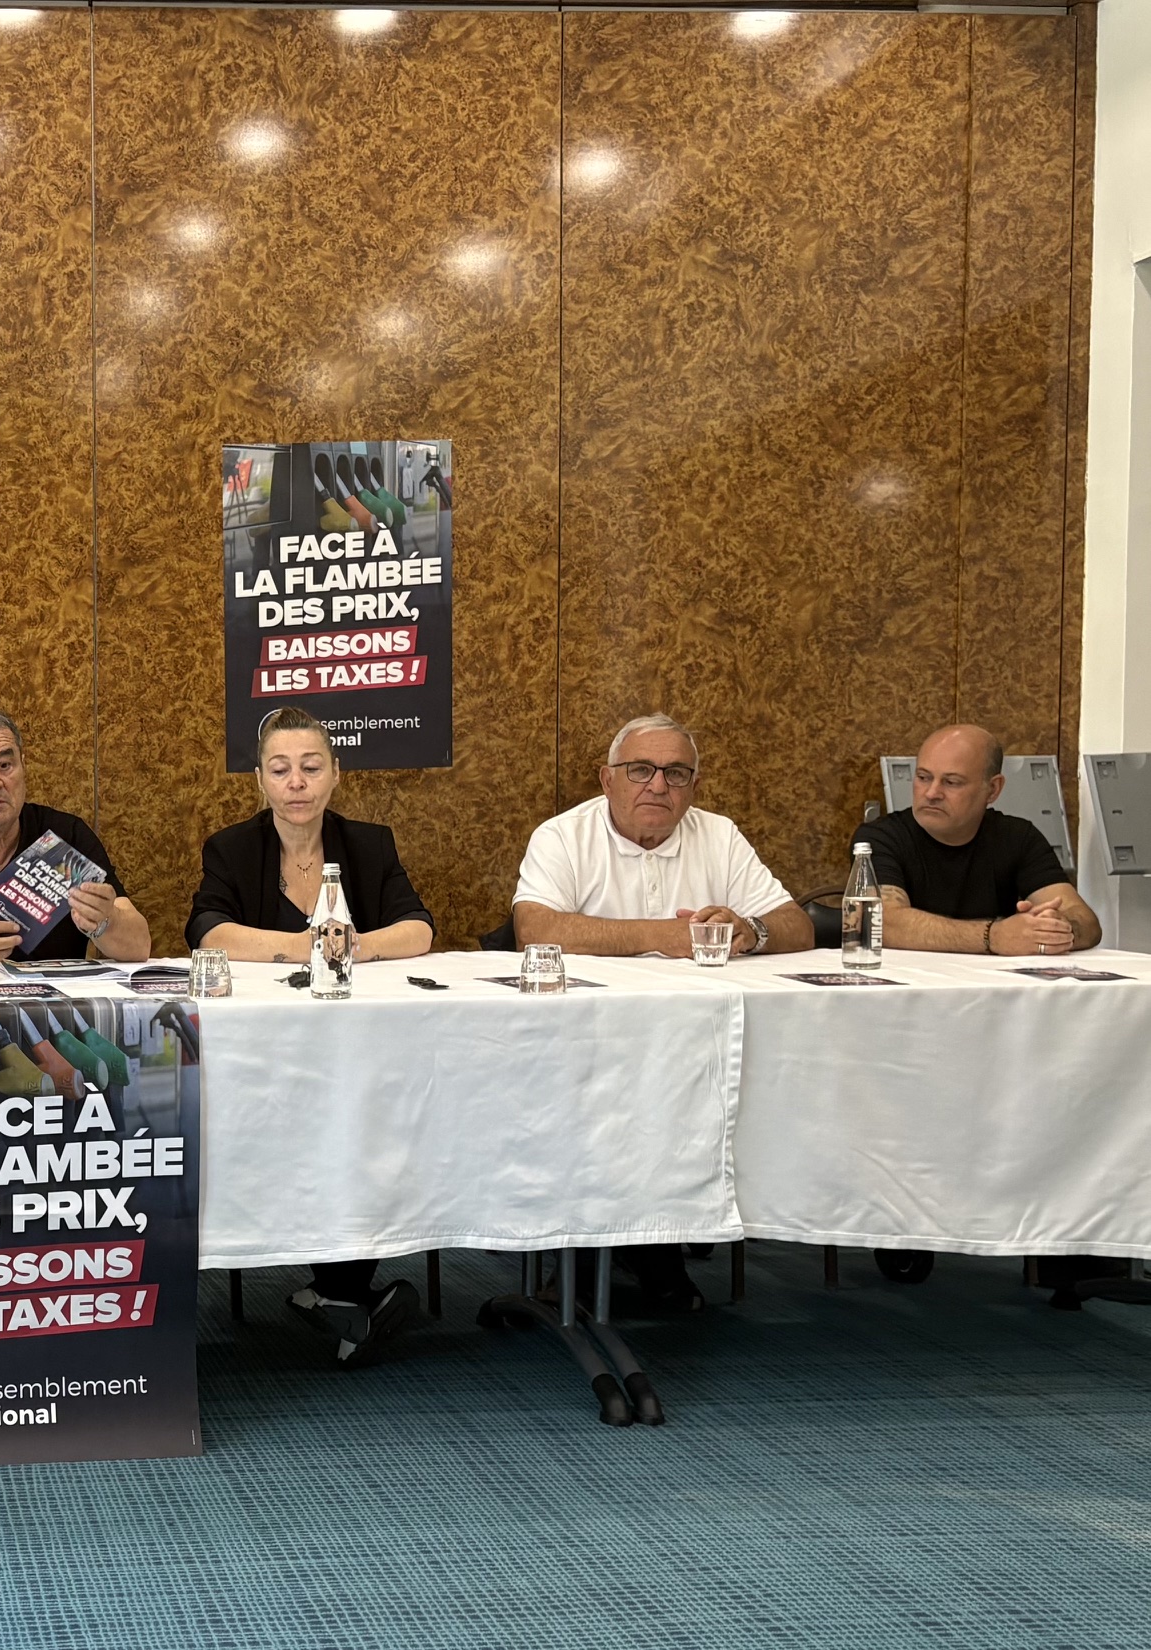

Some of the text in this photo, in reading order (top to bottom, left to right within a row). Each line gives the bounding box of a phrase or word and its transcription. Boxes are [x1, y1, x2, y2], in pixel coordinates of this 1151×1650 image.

[279, 523, 398, 563] FACE À
[235, 552, 442, 598] LA FLAMBÉE
[258, 591, 419, 628] DES PRIX,
[268, 630, 411, 662] BAISSONS
[261, 660, 420, 692] LES TAXES !
[15, 857, 31, 871] LA
[36, 860, 65, 882] FACE
[0, 884, 17, 900] LES
[16, 896, 43, 918] TAXES
[9, 879, 53, 912] BAISSONS
[15, 868, 63, 907] DES PRIX,
[74, 1082, 115, 1133] À
[13, 1187, 148, 1234] PRIX,
[131, 1290, 146, 1321] !
